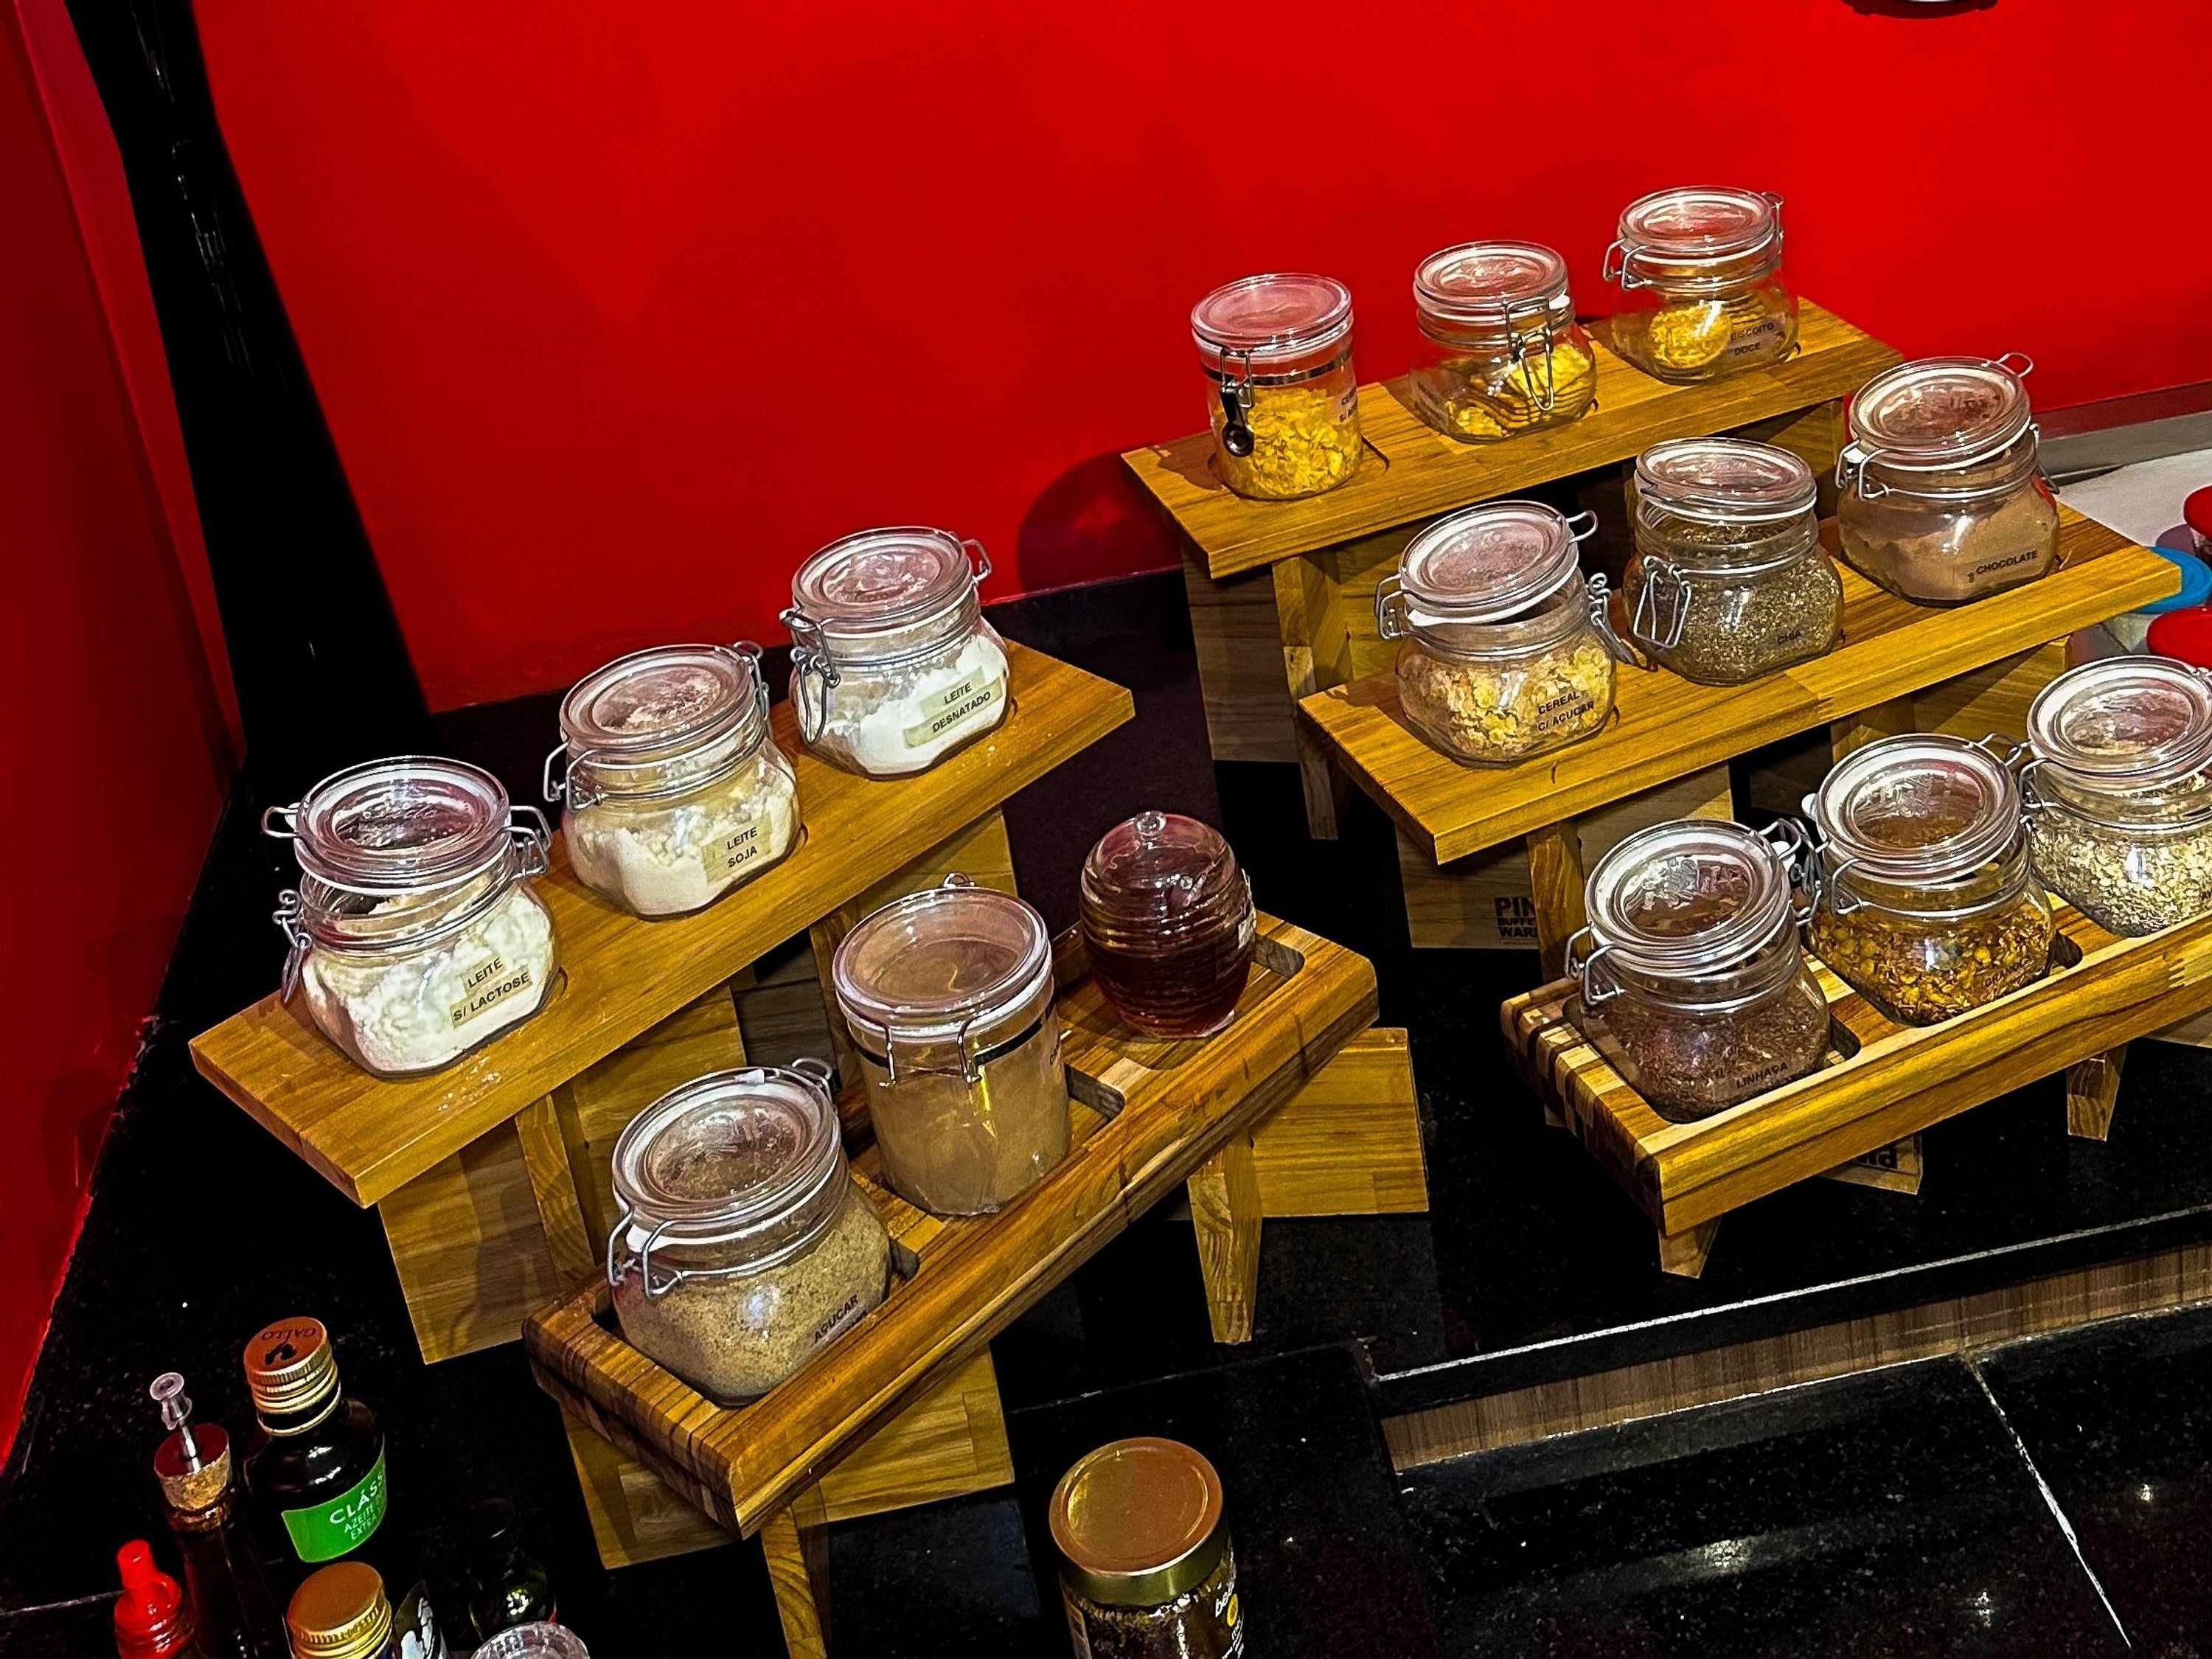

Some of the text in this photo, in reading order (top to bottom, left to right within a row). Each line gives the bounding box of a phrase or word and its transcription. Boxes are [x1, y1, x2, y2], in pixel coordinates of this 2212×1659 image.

[1734, 341, 1761, 356] DOCE
[1976, 549, 2038, 574] CHOCOLATE
[944, 681, 972, 705] LEITE
[1538, 691, 1580, 715] CEREAL
[932, 691, 991, 733] DESNATADO
[726, 827, 757, 850] LEITE
[728, 845, 757, 868] SOJA
[1494, 897, 1535, 917] PIN
[1497, 917, 1536, 926] BUFFE
[1498, 926, 1538, 938] WAR
[467, 957, 503, 989] LEITE
[453, 970, 530, 1021] S/ LACTOSE
[261, 1326, 317, 1342] GALLO
[330, 1472, 384, 1525] CLÁSS
[344, 1505, 376, 1534] AZEITE
